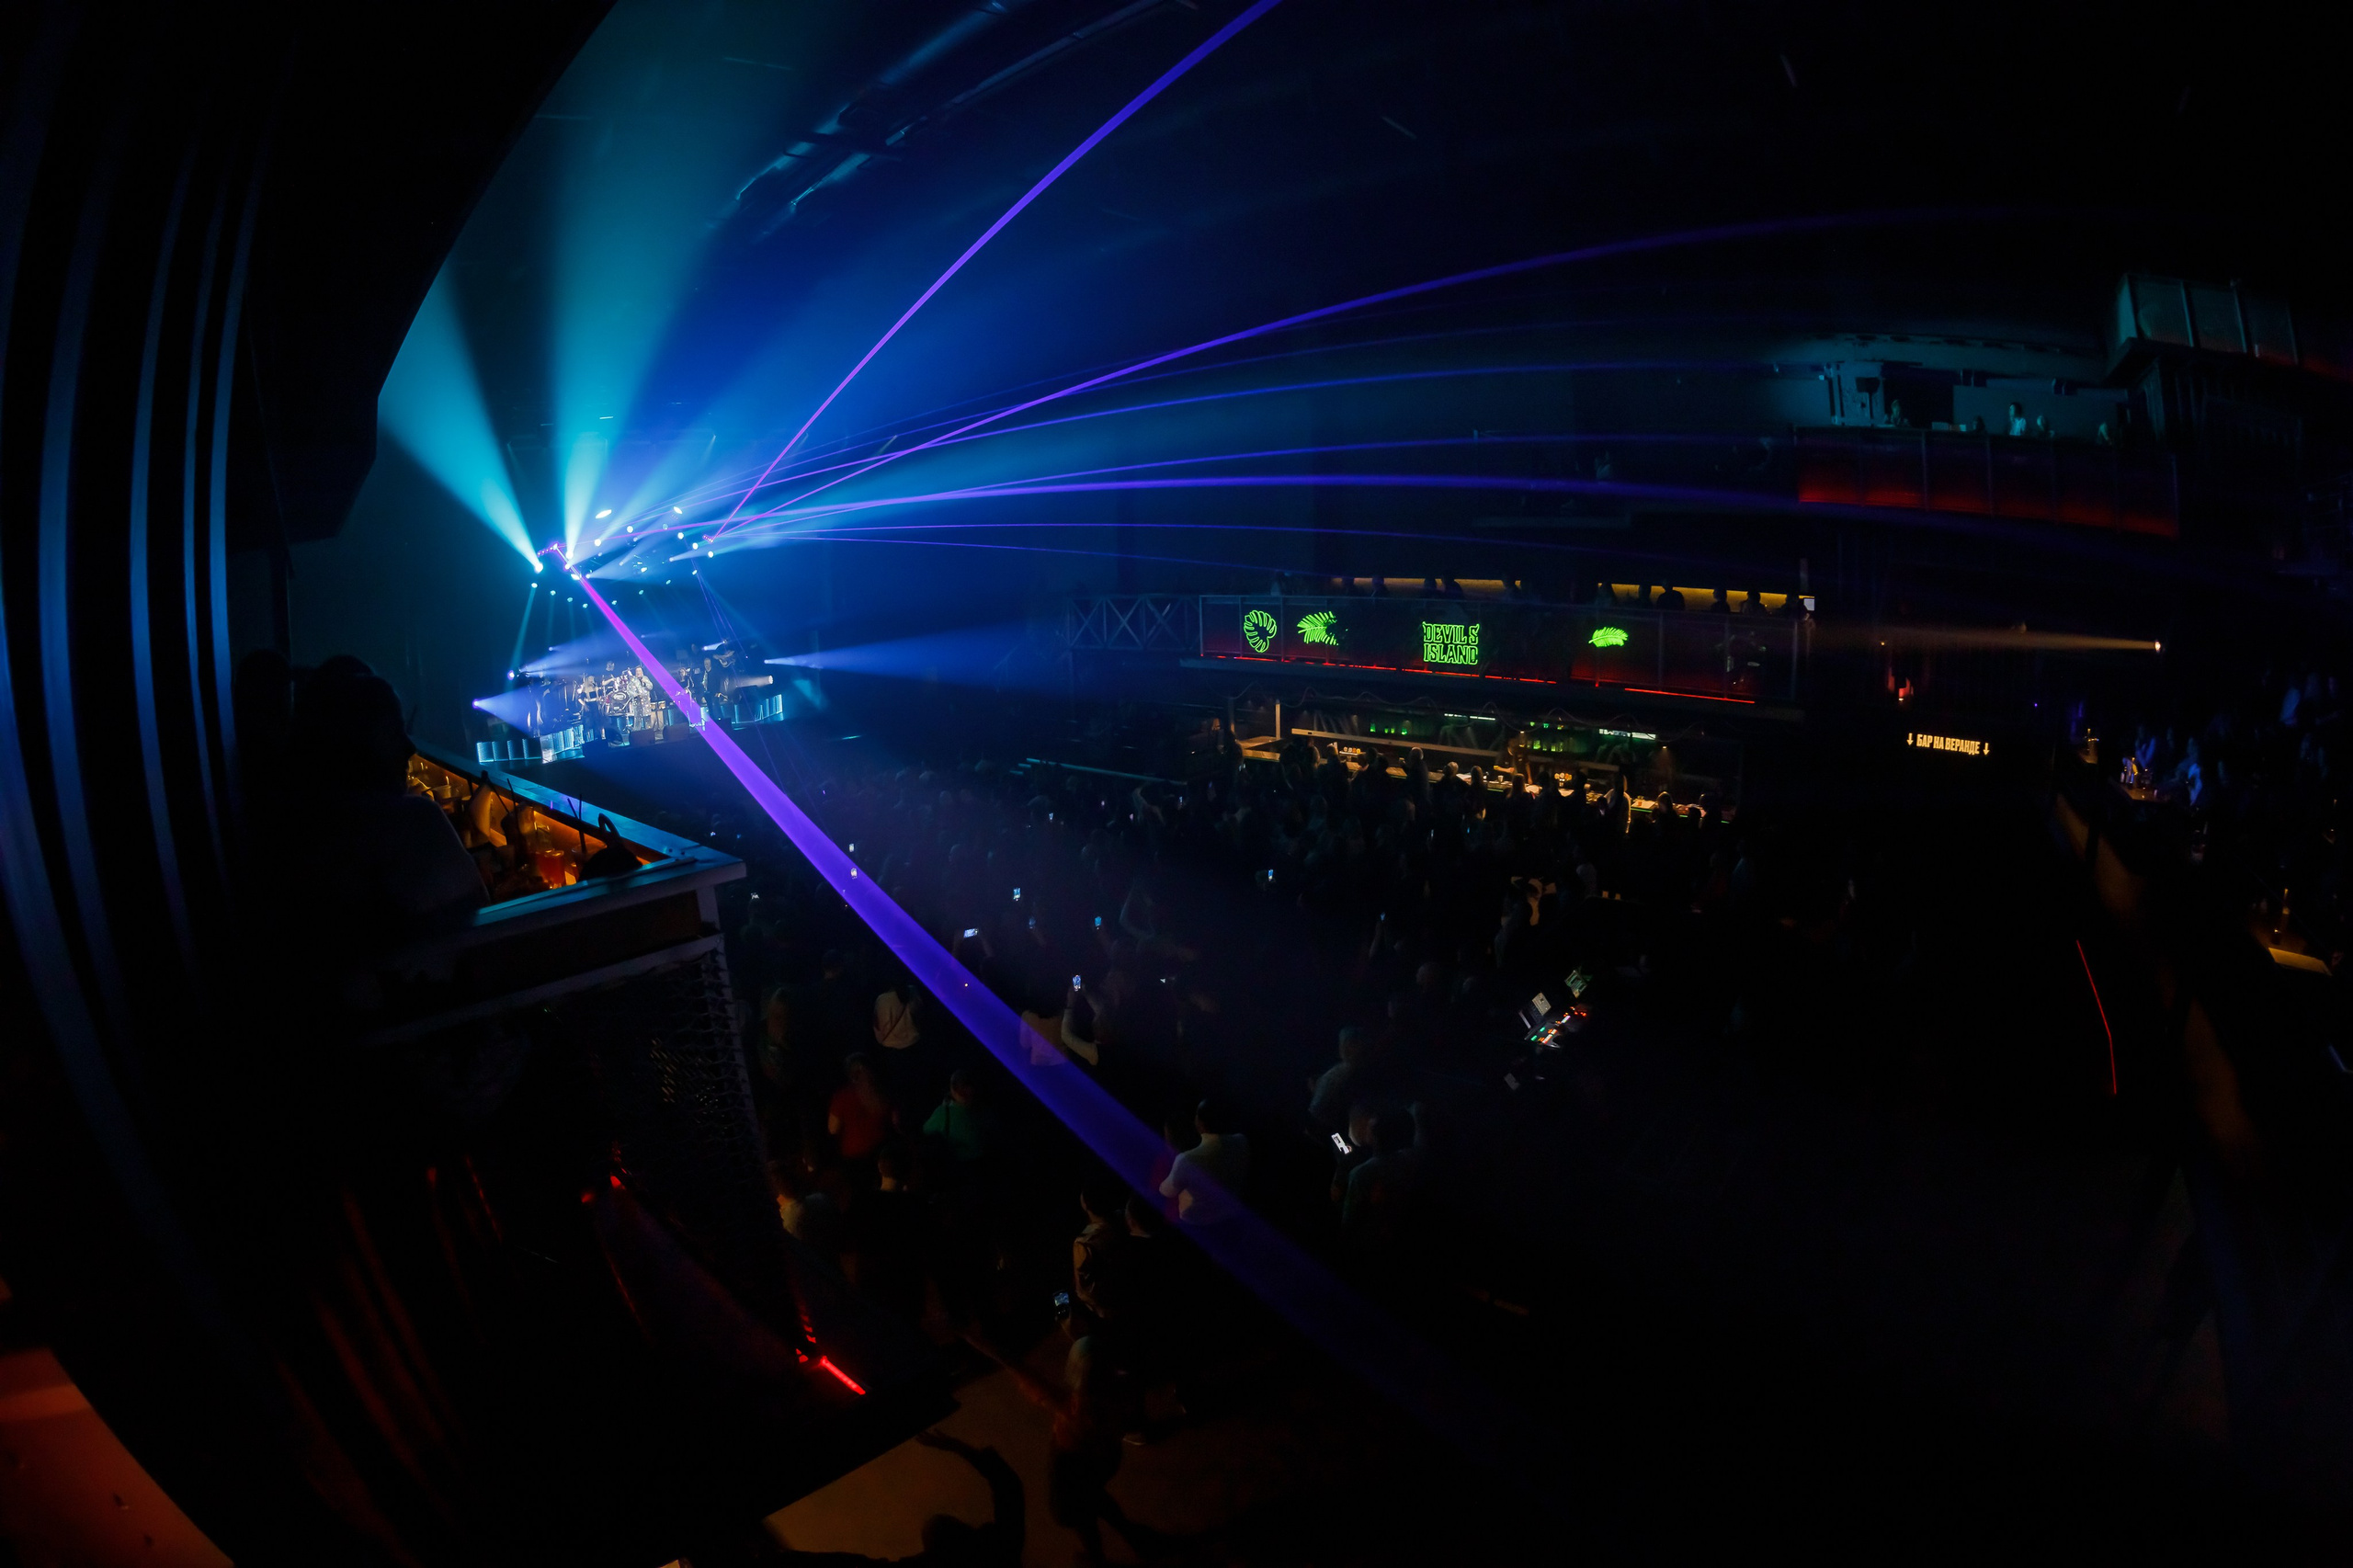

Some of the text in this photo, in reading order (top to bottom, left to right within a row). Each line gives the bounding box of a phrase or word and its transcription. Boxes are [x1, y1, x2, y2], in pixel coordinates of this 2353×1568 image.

[1423, 643, 1478, 665] ISLAND
[1916, 733, 1981, 755] БАР НА ВЕРАНДЕ
